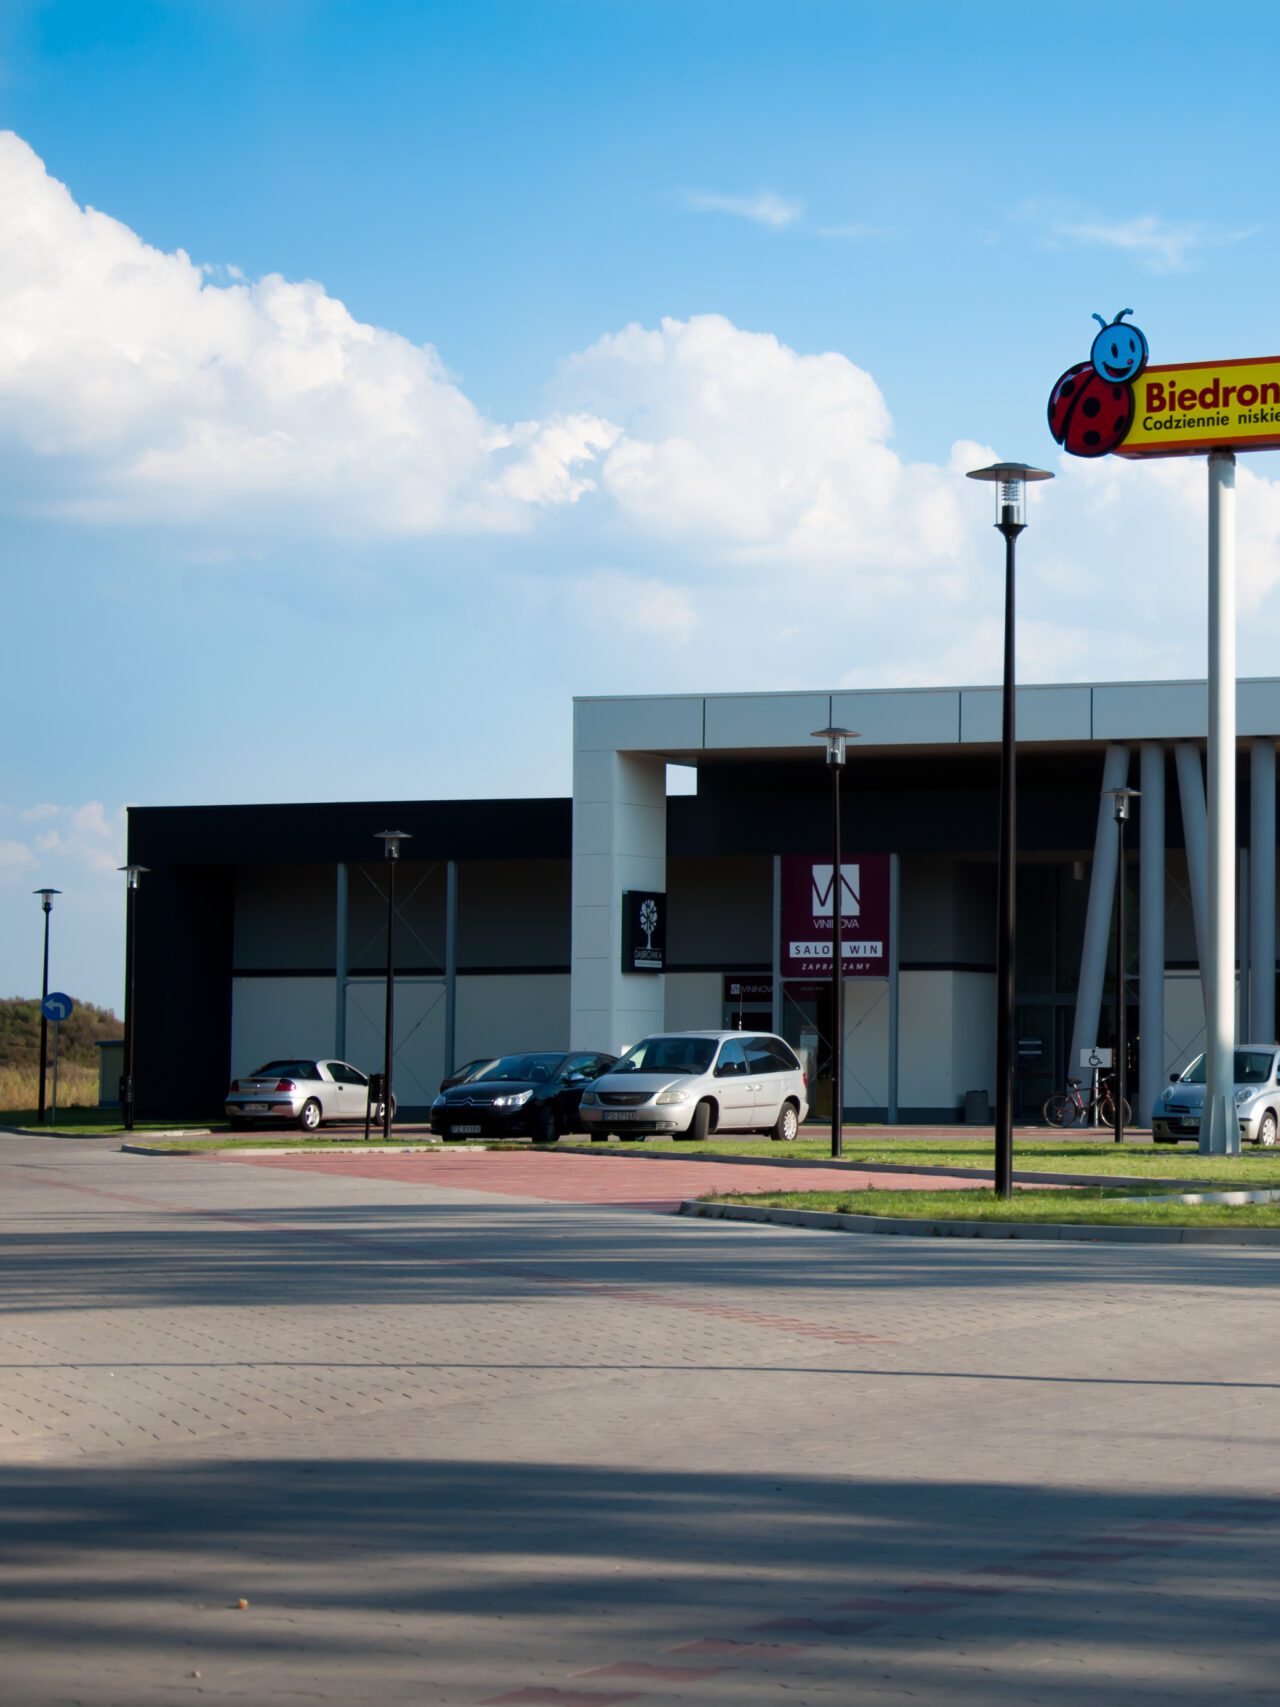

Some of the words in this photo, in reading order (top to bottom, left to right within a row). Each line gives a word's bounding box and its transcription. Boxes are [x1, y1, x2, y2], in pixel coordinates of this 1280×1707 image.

[1143, 411, 1230, 431] Codziennie
[813, 919, 859, 929] VINIOVA
[794, 945, 831, 955] SALO
[849, 945, 878, 954] WIN
